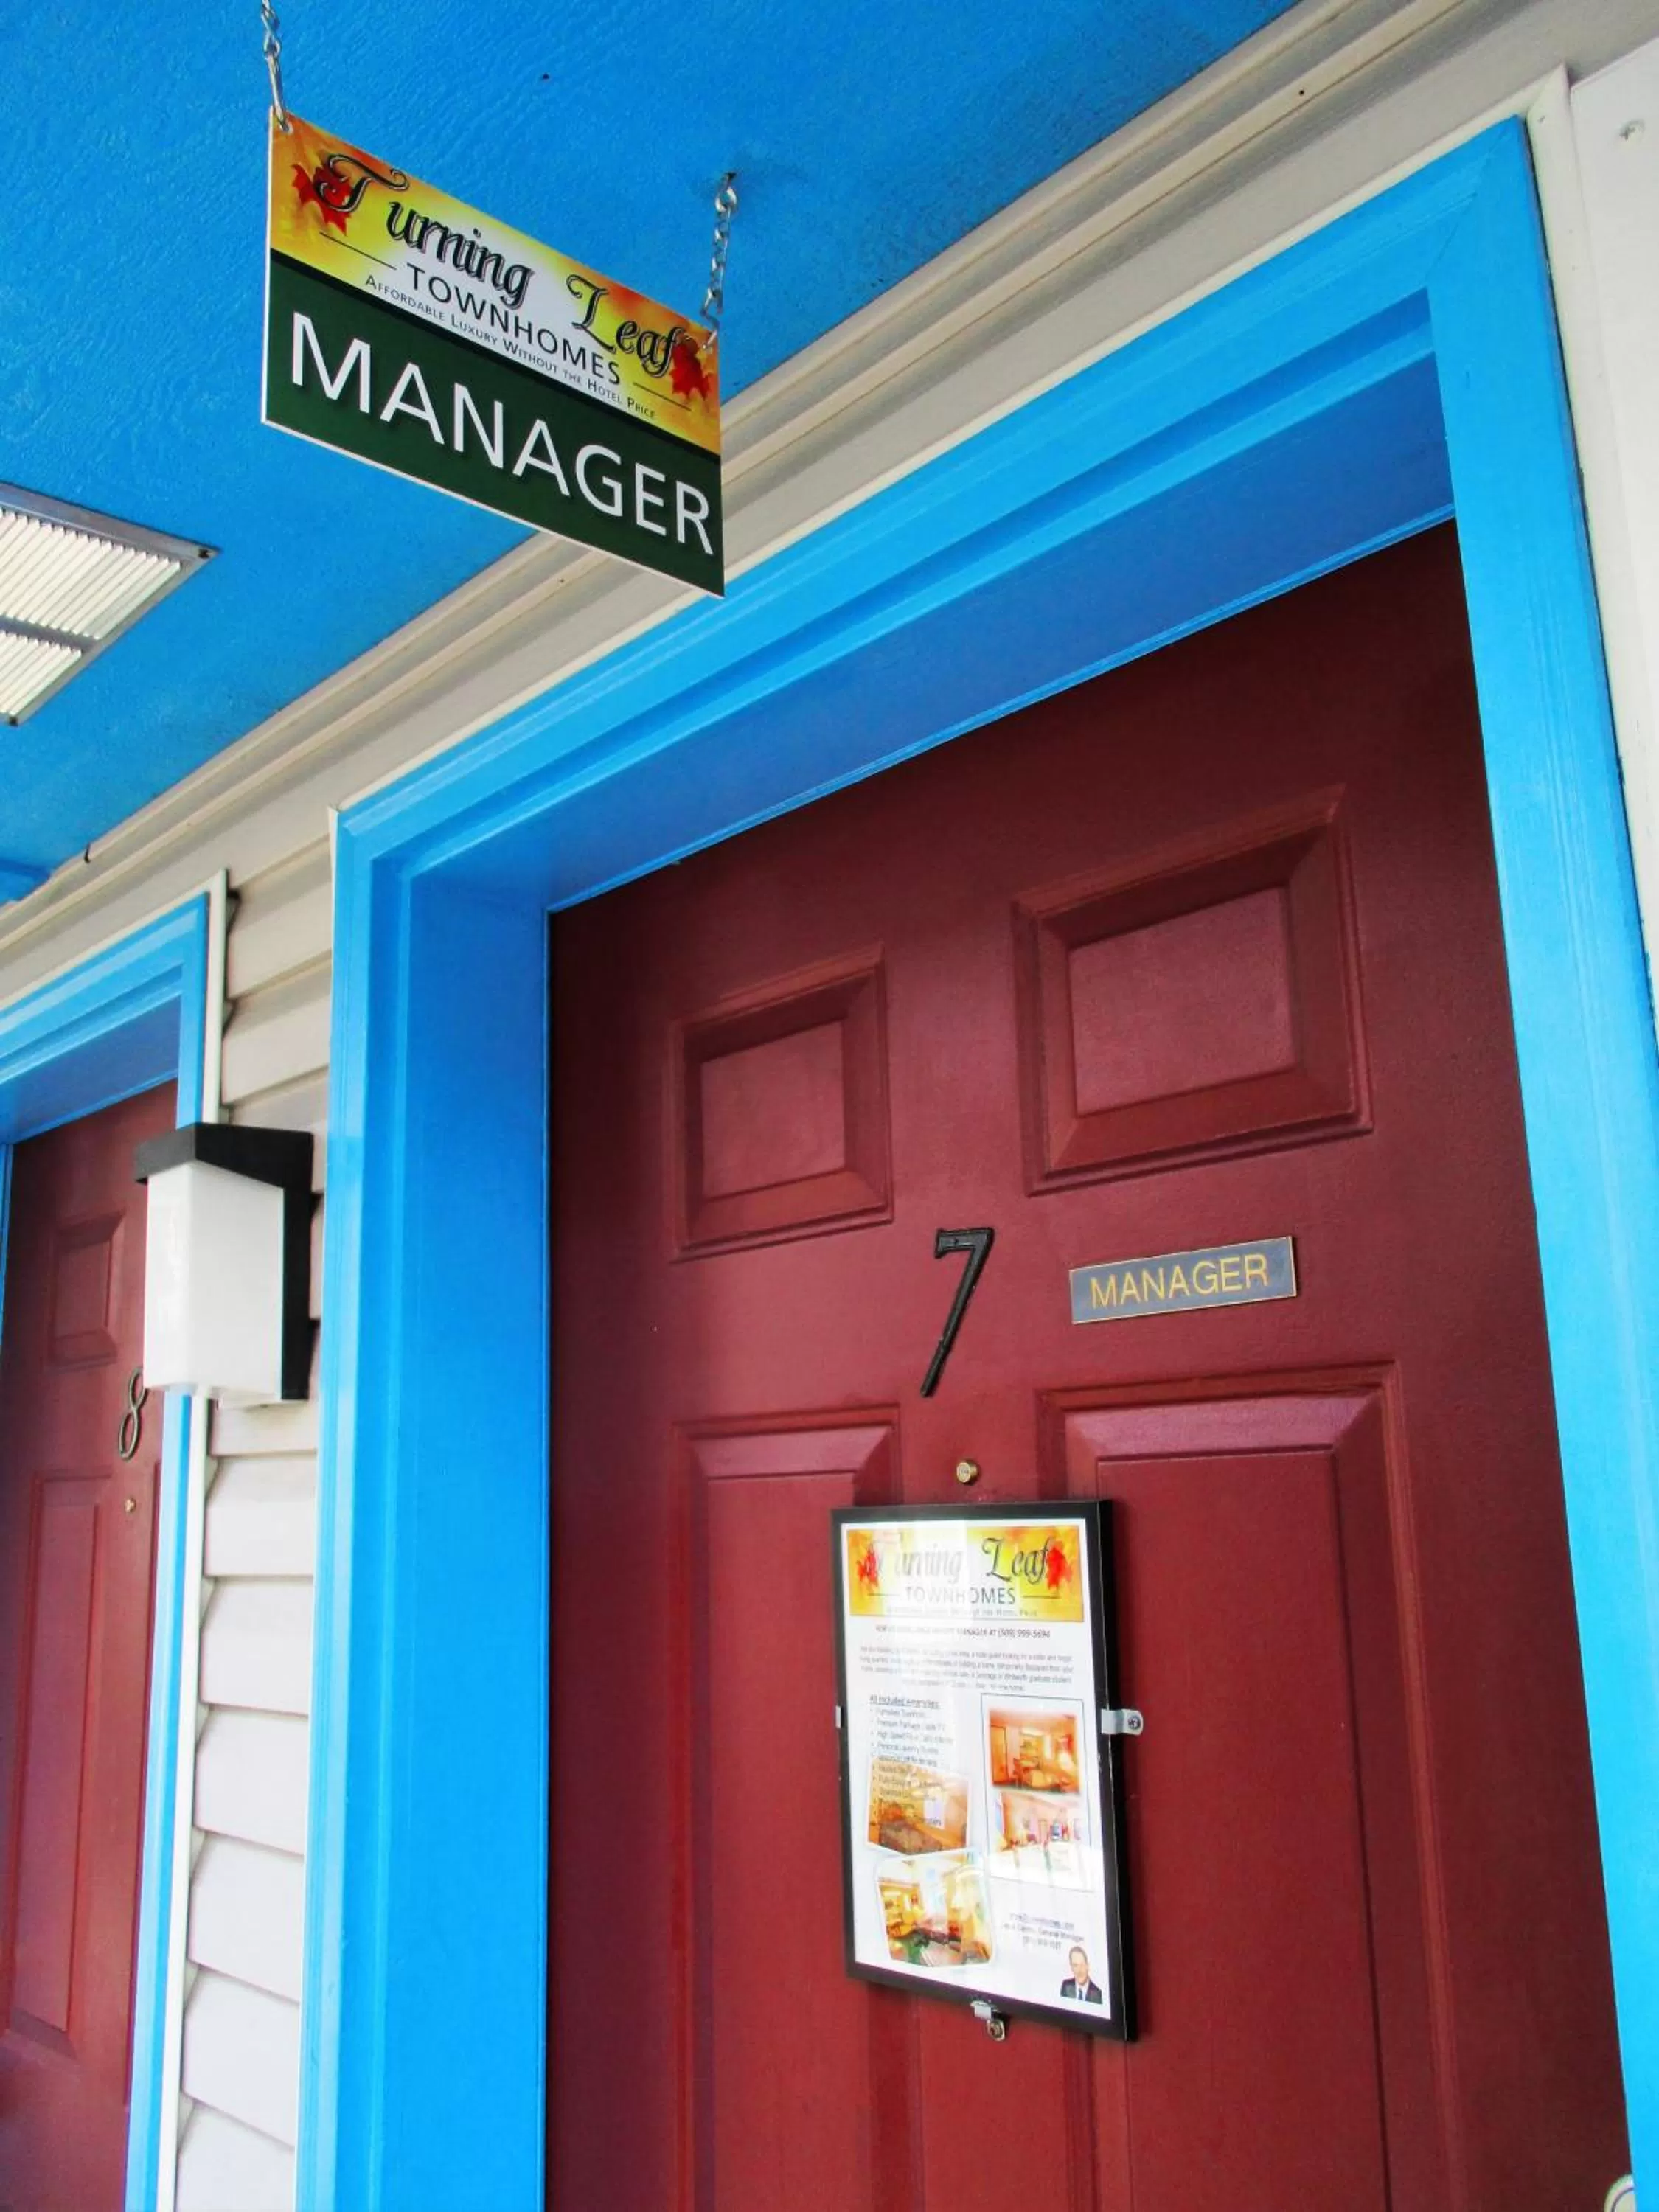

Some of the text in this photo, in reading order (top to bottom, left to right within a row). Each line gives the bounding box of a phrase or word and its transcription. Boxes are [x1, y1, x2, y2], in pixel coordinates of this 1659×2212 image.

[317, 153, 686, 378] Turning Leaf
[406, 262, 621, 385] TOWNHOMES
[292, 312, 714, 554] MANAGER
[920, 1227, 995, 1399] 7
[1089, 1253, 1270, 1310] MANAGER
[118, 1367, 147, 1462] 8
[982, 1535, 1055, 1585] Leaf
